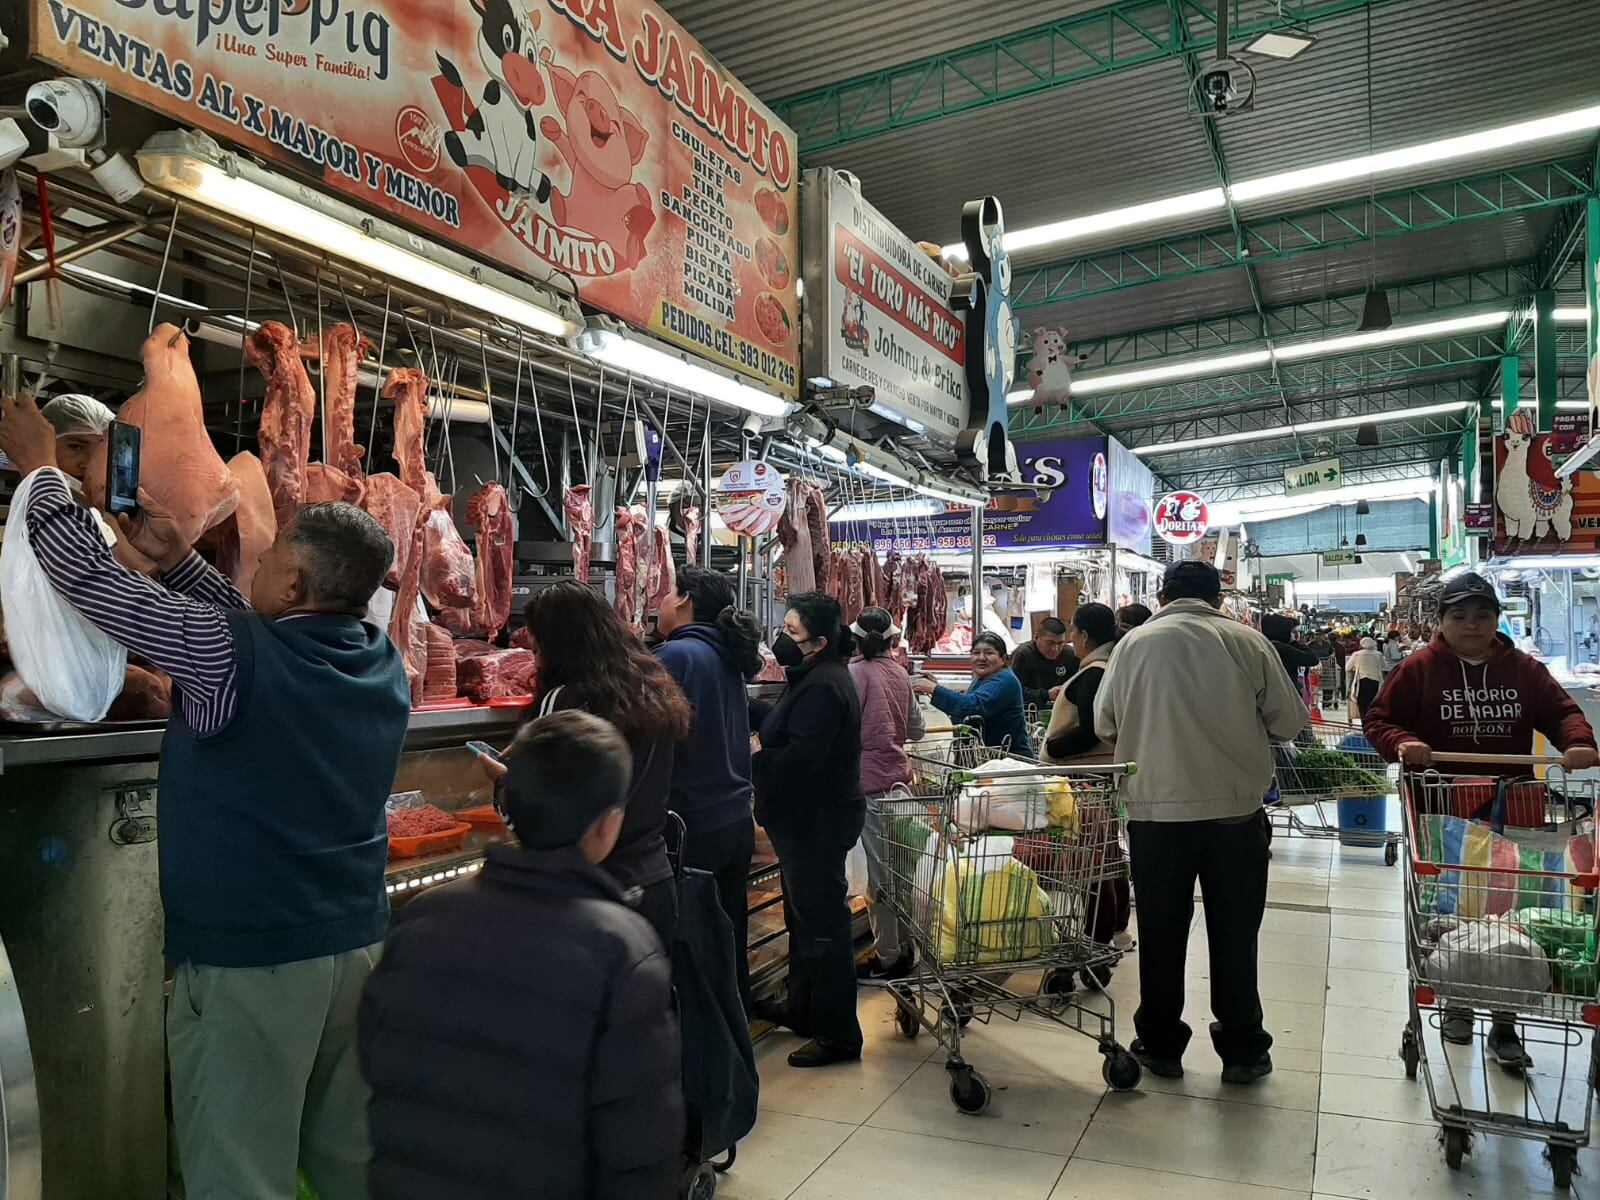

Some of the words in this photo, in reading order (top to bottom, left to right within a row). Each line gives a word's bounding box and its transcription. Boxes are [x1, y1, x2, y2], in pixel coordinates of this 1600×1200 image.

[216, 33, 257, 57] ¡Una
[265, 42, 308, 68] Super
[315, 53, 371, 81] Familia!
[48, 0, 193, 98] VENTAS
[198, 76, 239, 122] AL
[243, 96, 266, 135] X
[270, 108, 361, 179] MAYOR
[364, 155, 383, 188] Y
[384, 166, 461, 227] MENOR
[633, 12, 791, 191] JAIMITO
[672, 121, 742, 185] CHULETAS
[693, 157, 723, 188] BIFE
[683, 187, 733, 230] PECETO
[693, 174, 725, 207] TIRA
[495, 195, 615, 275] JAIMITO
[661, 192, 751, 260] SANCOCHADO
[687, 226, 731, 265] PULPA
[685, 244, 732, 282] BISTEC
[853, 206, 912, 272] DISTRIBUIDORA
[912, 258, 922, 281] DE
[923, 268, 947, 301] CARNES
[684, 262, 734, 301] PICADA
[684, 281, 734, 320] MOLIDA
[870, 263, 903, 312] TORO
[906, 291, 931, 332] MÁS
[740, 341, 759, 370] 983
[761, 351, 777, 379] 012
[779, 361, 795, 387] 246
[841, 355, 860, 377] CARNE
[874, 326, 919, 382] Johnny
[921, 356, 931, 382] &
[934, 363, 962, 401] Erika
[937, 535, 955, 548] 958
[1440, 704, 1464, 720] DE
